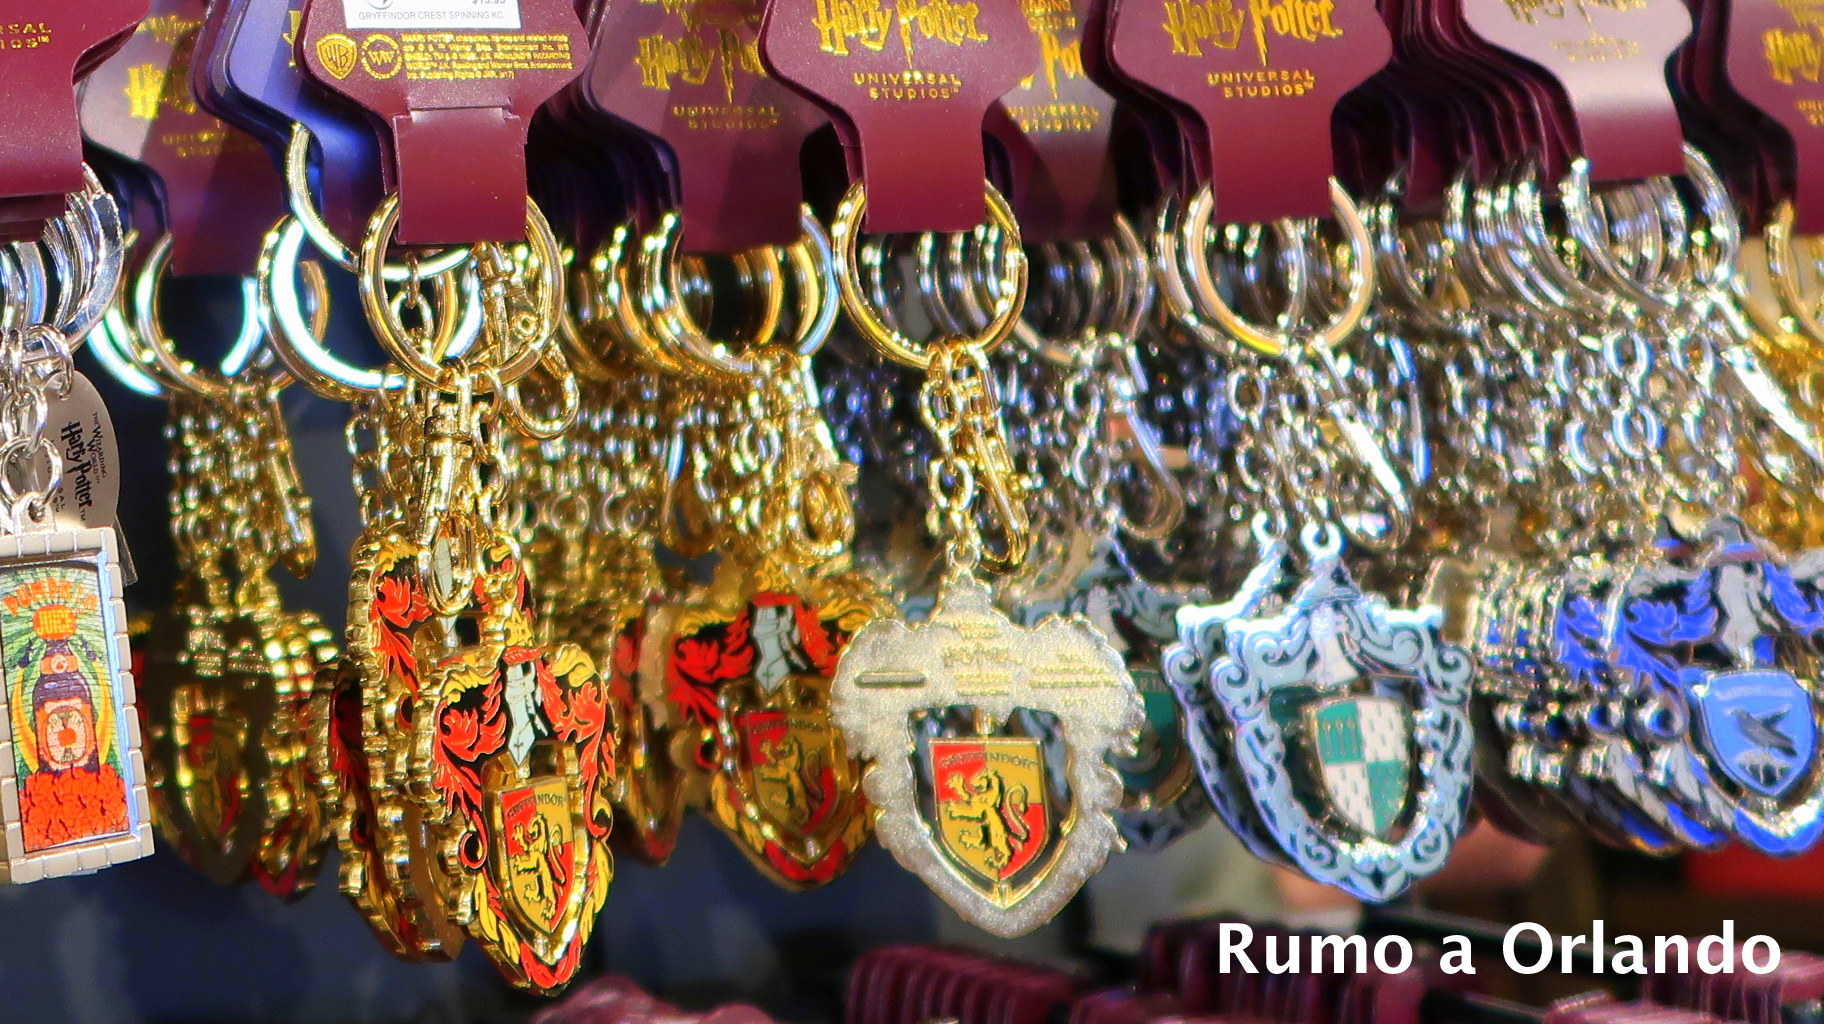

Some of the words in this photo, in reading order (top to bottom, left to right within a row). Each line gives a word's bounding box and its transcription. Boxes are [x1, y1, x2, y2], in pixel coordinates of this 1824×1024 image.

[358, 10, 415, 21] GRYFFINDOR
[420, 10, 447, 21] CREST
[448, 10, 490, 21] SPINNING
[491, 10, 504, 20] KC
[634, 33, 715, 91] Harry
[853, 71, 963, 86] UNIVERSAL
[60, 421, 85, 463] Harry
[86, 438, 100, 475] WORLD
[91, 423, 108, 479] WIZARDING
[37, 609, 74, 636] JUICE
